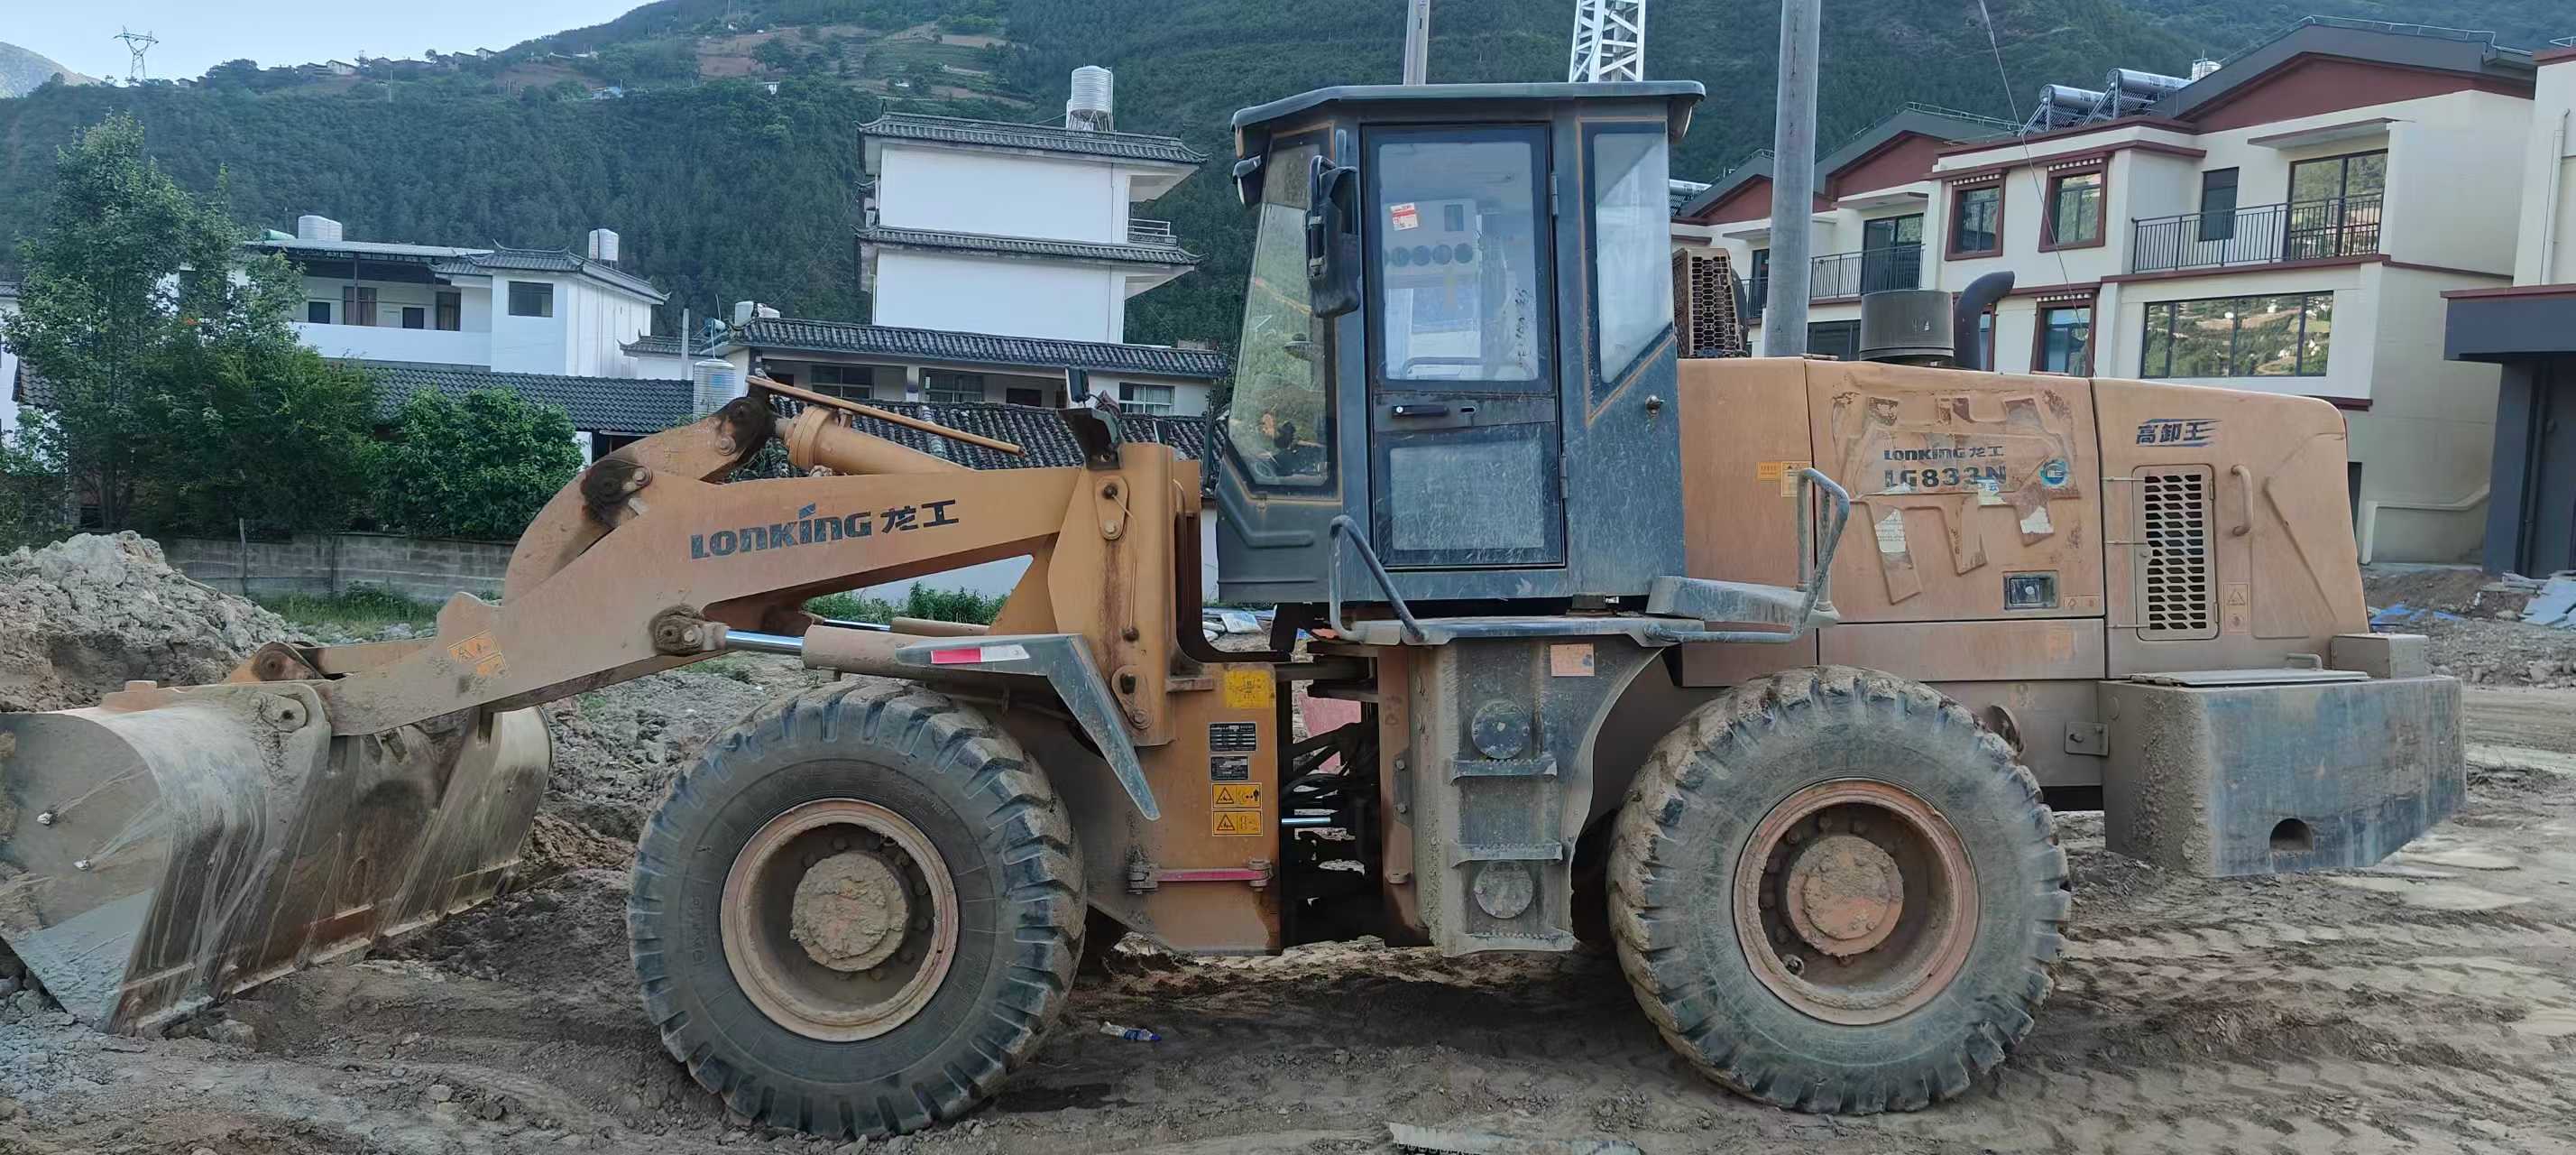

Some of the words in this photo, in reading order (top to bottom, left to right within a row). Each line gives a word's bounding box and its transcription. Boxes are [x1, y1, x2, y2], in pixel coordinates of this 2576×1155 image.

[2136, 422, 2215, 444] 高卸王
[1969, 446, 2005, 458] 龙工
[1884, 465, 2007, 488] LG833N
[880, 499, 959, 533] 龙工
